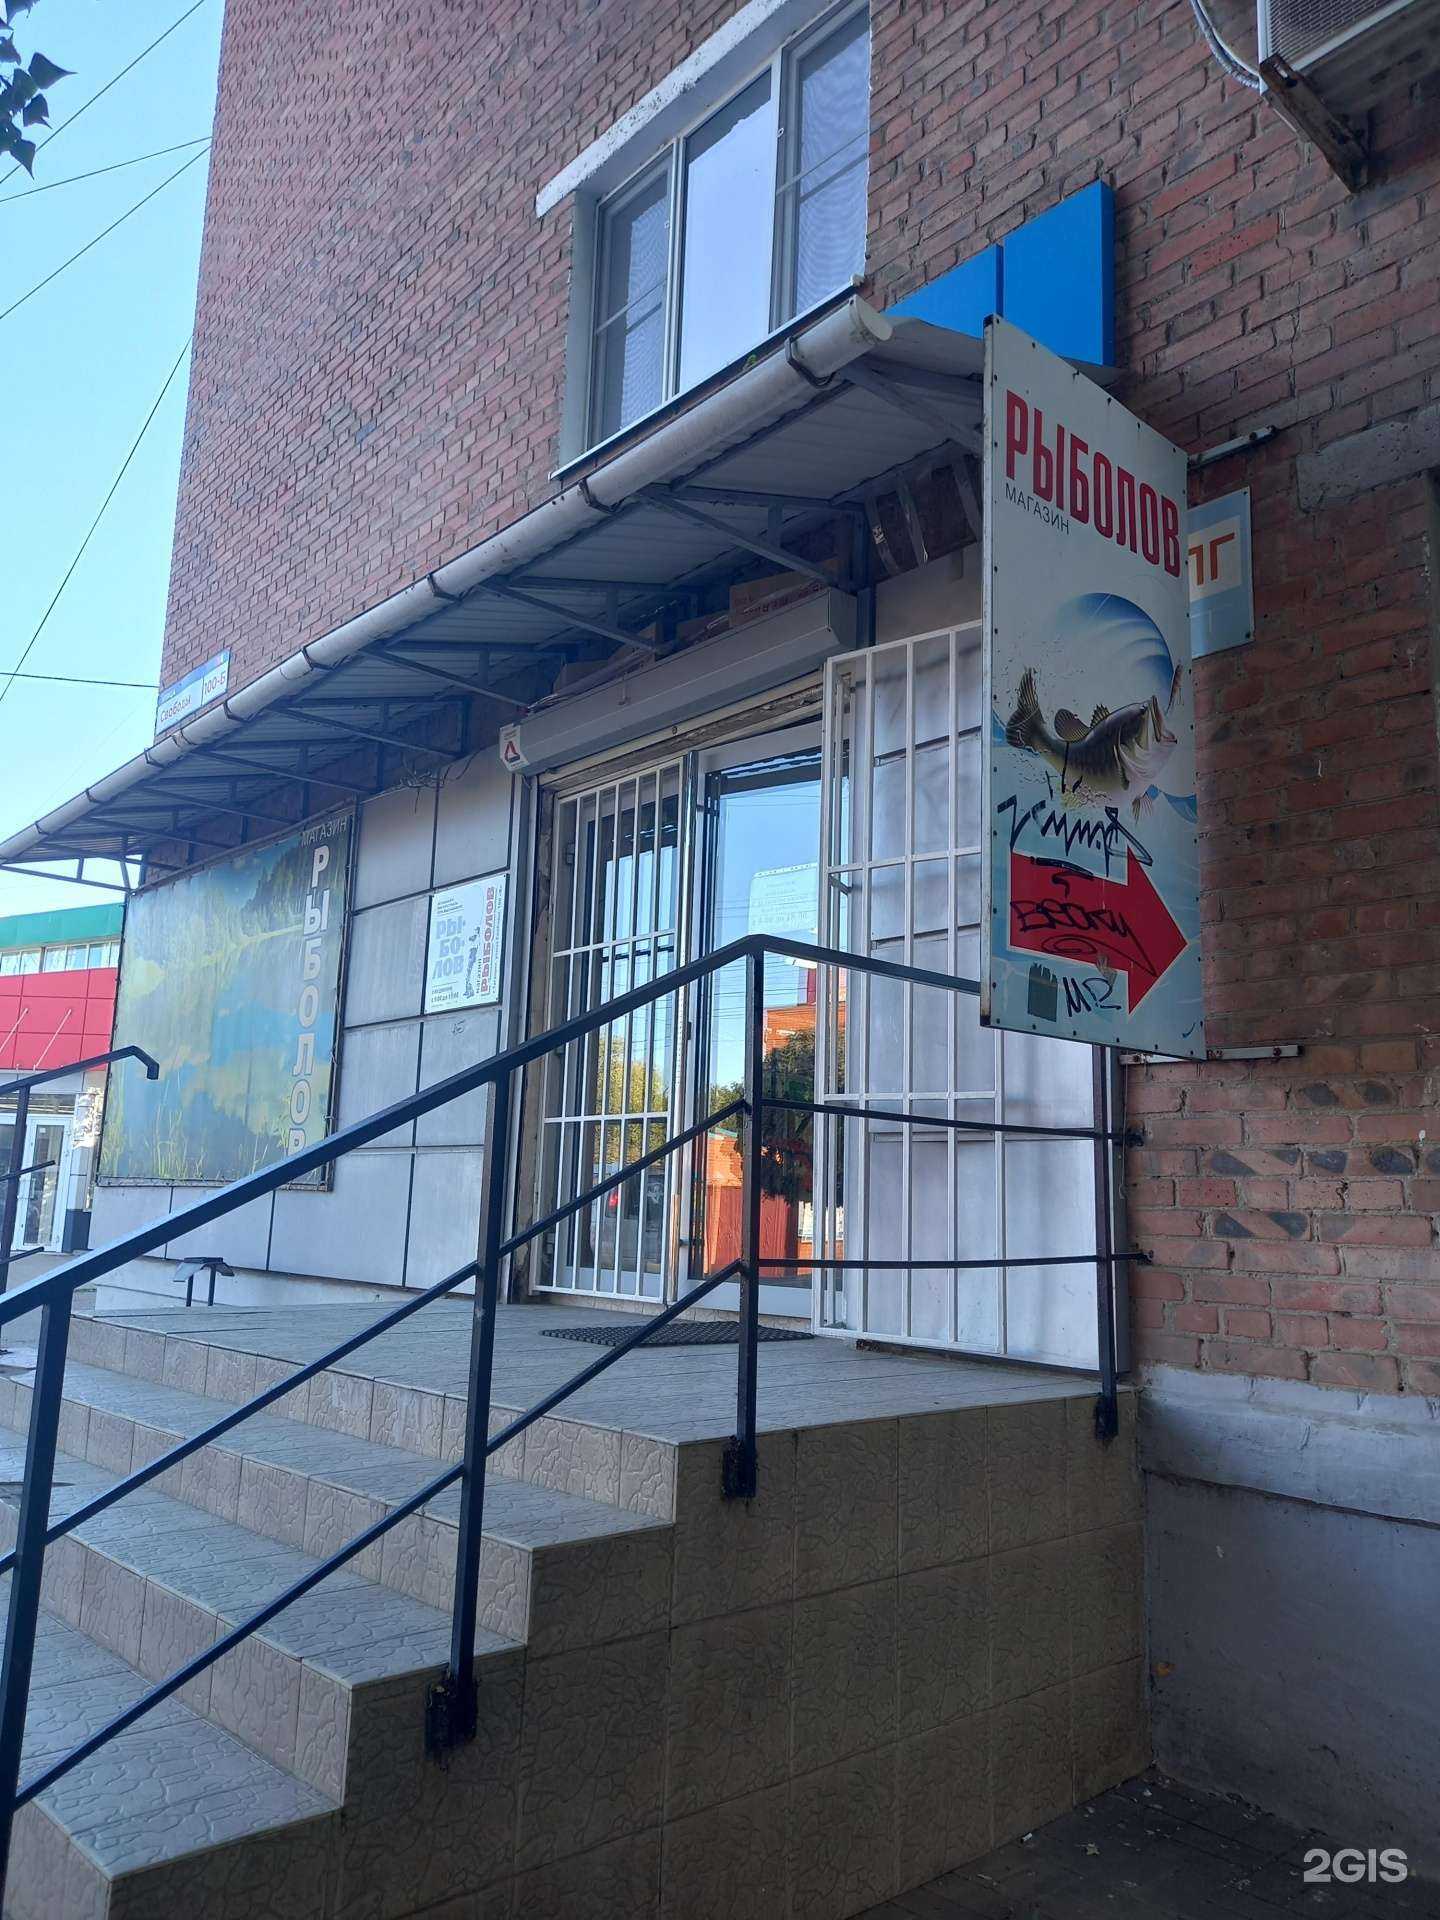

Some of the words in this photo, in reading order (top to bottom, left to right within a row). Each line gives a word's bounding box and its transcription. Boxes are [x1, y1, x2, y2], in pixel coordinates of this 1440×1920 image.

[1005, 483, 1070, 535] МАГАЗИН
[1006, 389, 1180, 578] РЫБОЛОВ
[300, 815, 348, 847] МАГАЗИН
